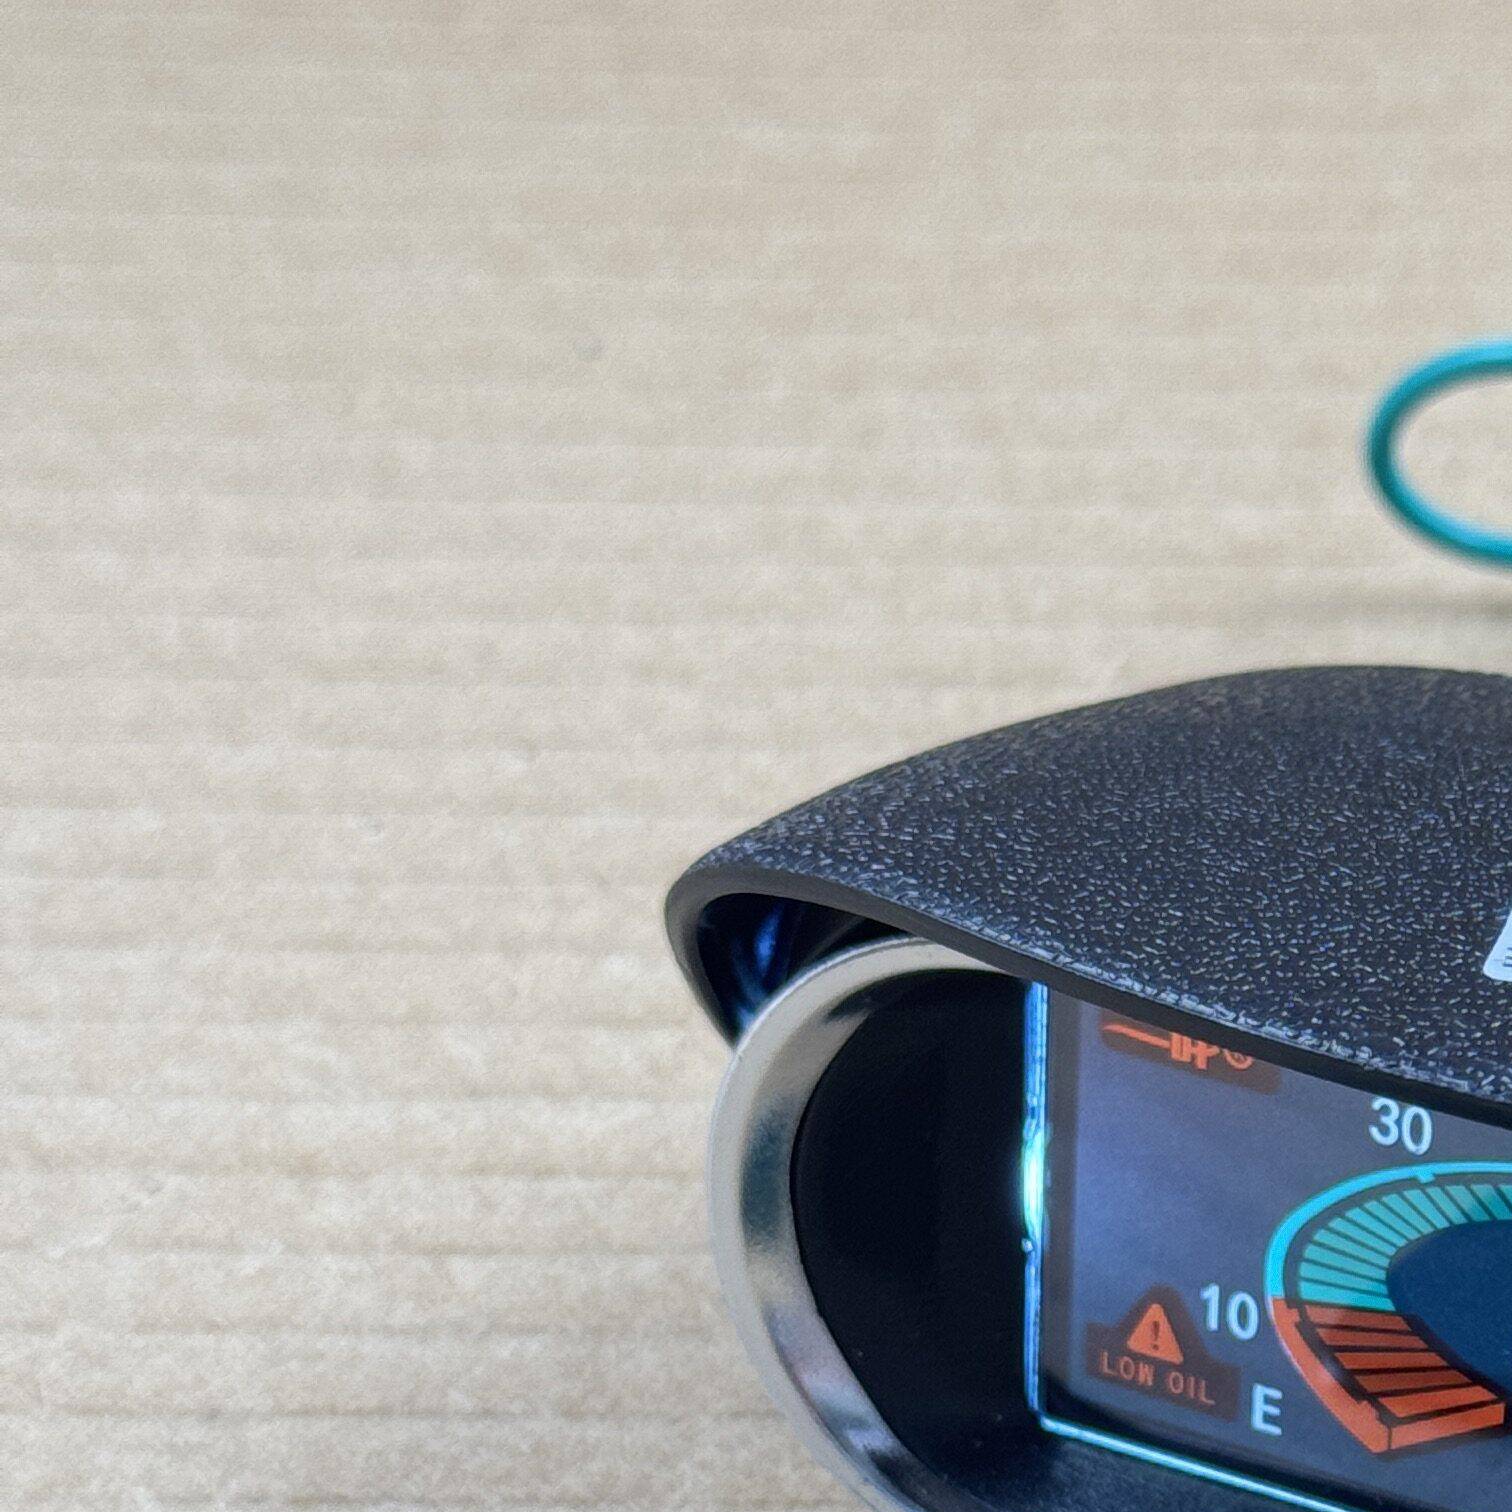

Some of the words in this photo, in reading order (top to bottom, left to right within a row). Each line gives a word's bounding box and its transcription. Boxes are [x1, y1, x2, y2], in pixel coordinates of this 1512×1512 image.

[1370, 1097, 1433, 1154] 30
[1201, 1284, 1259, 1340] 10
[1101, 1351, 1156, 1386] LOW
[1167, 1370, 1215, 1406] OIL
[1250, 1384, 1283, 1436] E
